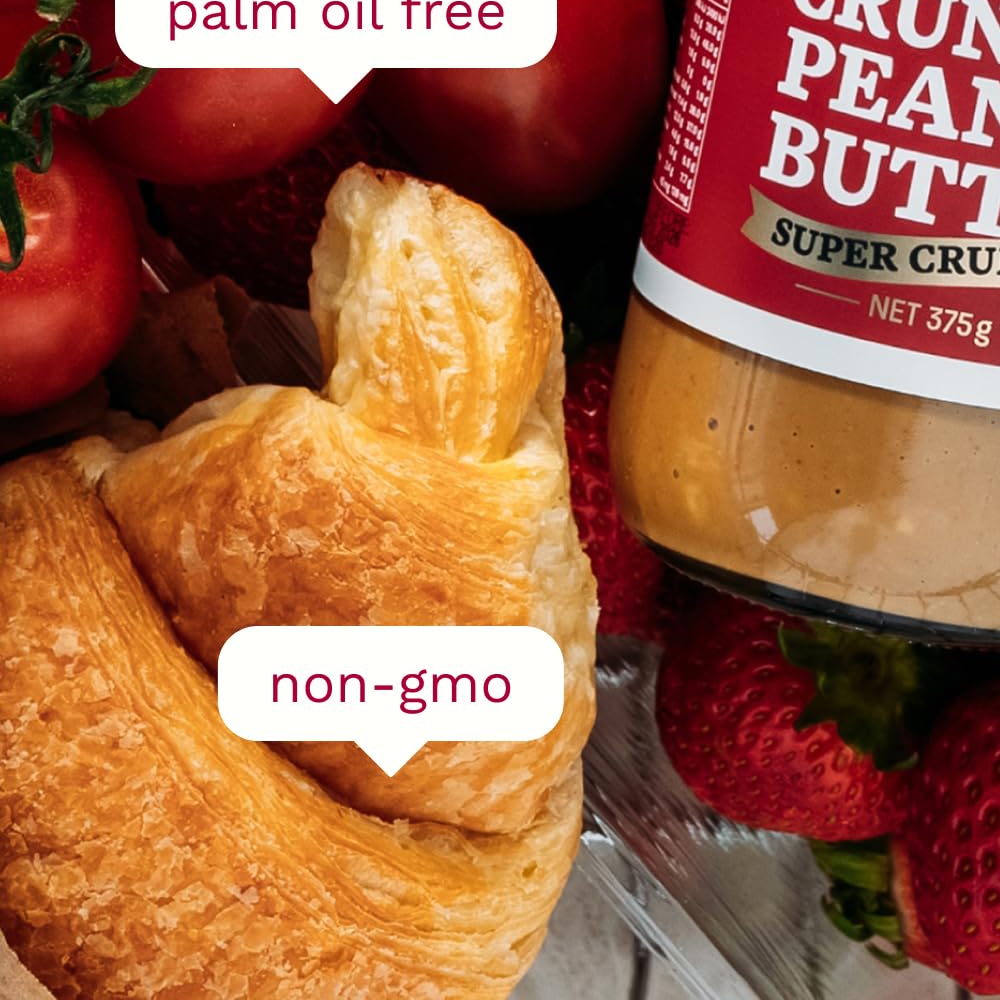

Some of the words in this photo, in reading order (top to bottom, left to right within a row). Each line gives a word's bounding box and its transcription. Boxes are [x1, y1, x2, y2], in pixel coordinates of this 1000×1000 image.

[771, 218, 898, 272] SUPER
[869, 294, 921, 326] NET
[926, 306, 993, 348] 375g
